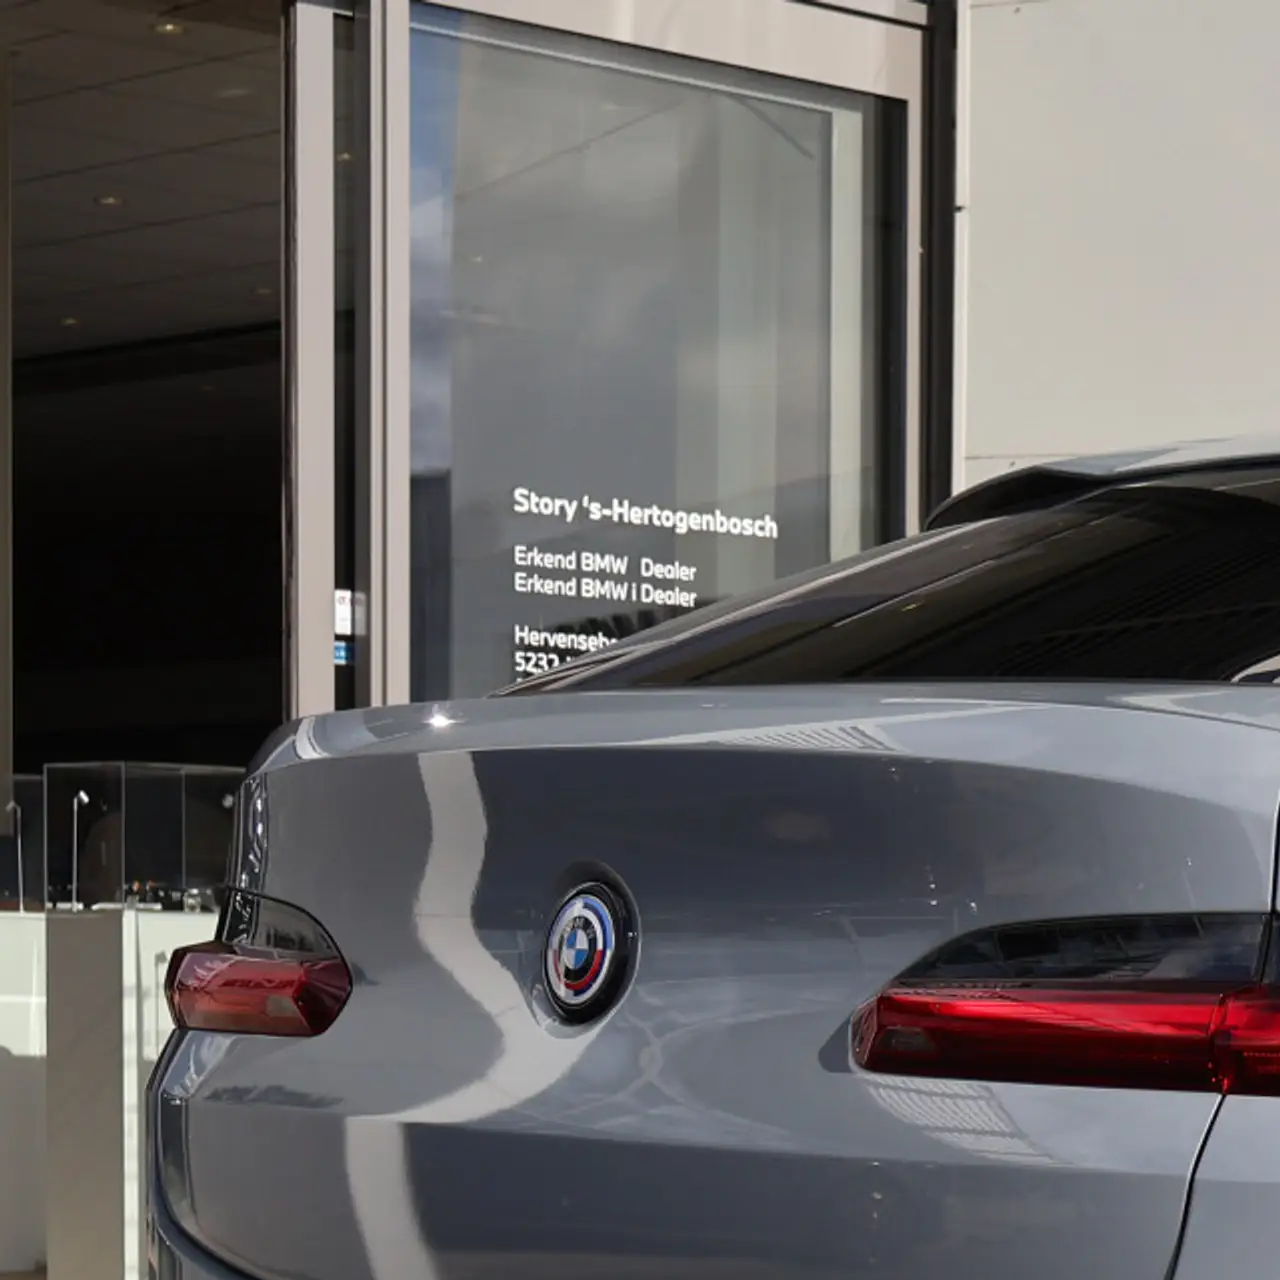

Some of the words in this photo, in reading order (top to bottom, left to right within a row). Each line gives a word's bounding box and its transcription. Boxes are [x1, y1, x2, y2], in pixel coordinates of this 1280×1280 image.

[514, 487, 577, 522] Story
[515, 546, 576, 570] Erkend
[581, 552, 628, 575] BMW
[641, 557, 697, 582] Dealer
[515, 573, 576, 597] Erkend
[581, 578, 628, 601] BMW
[632, 583, 637, 601] i
[641, 584, 697, 608] Dealer
